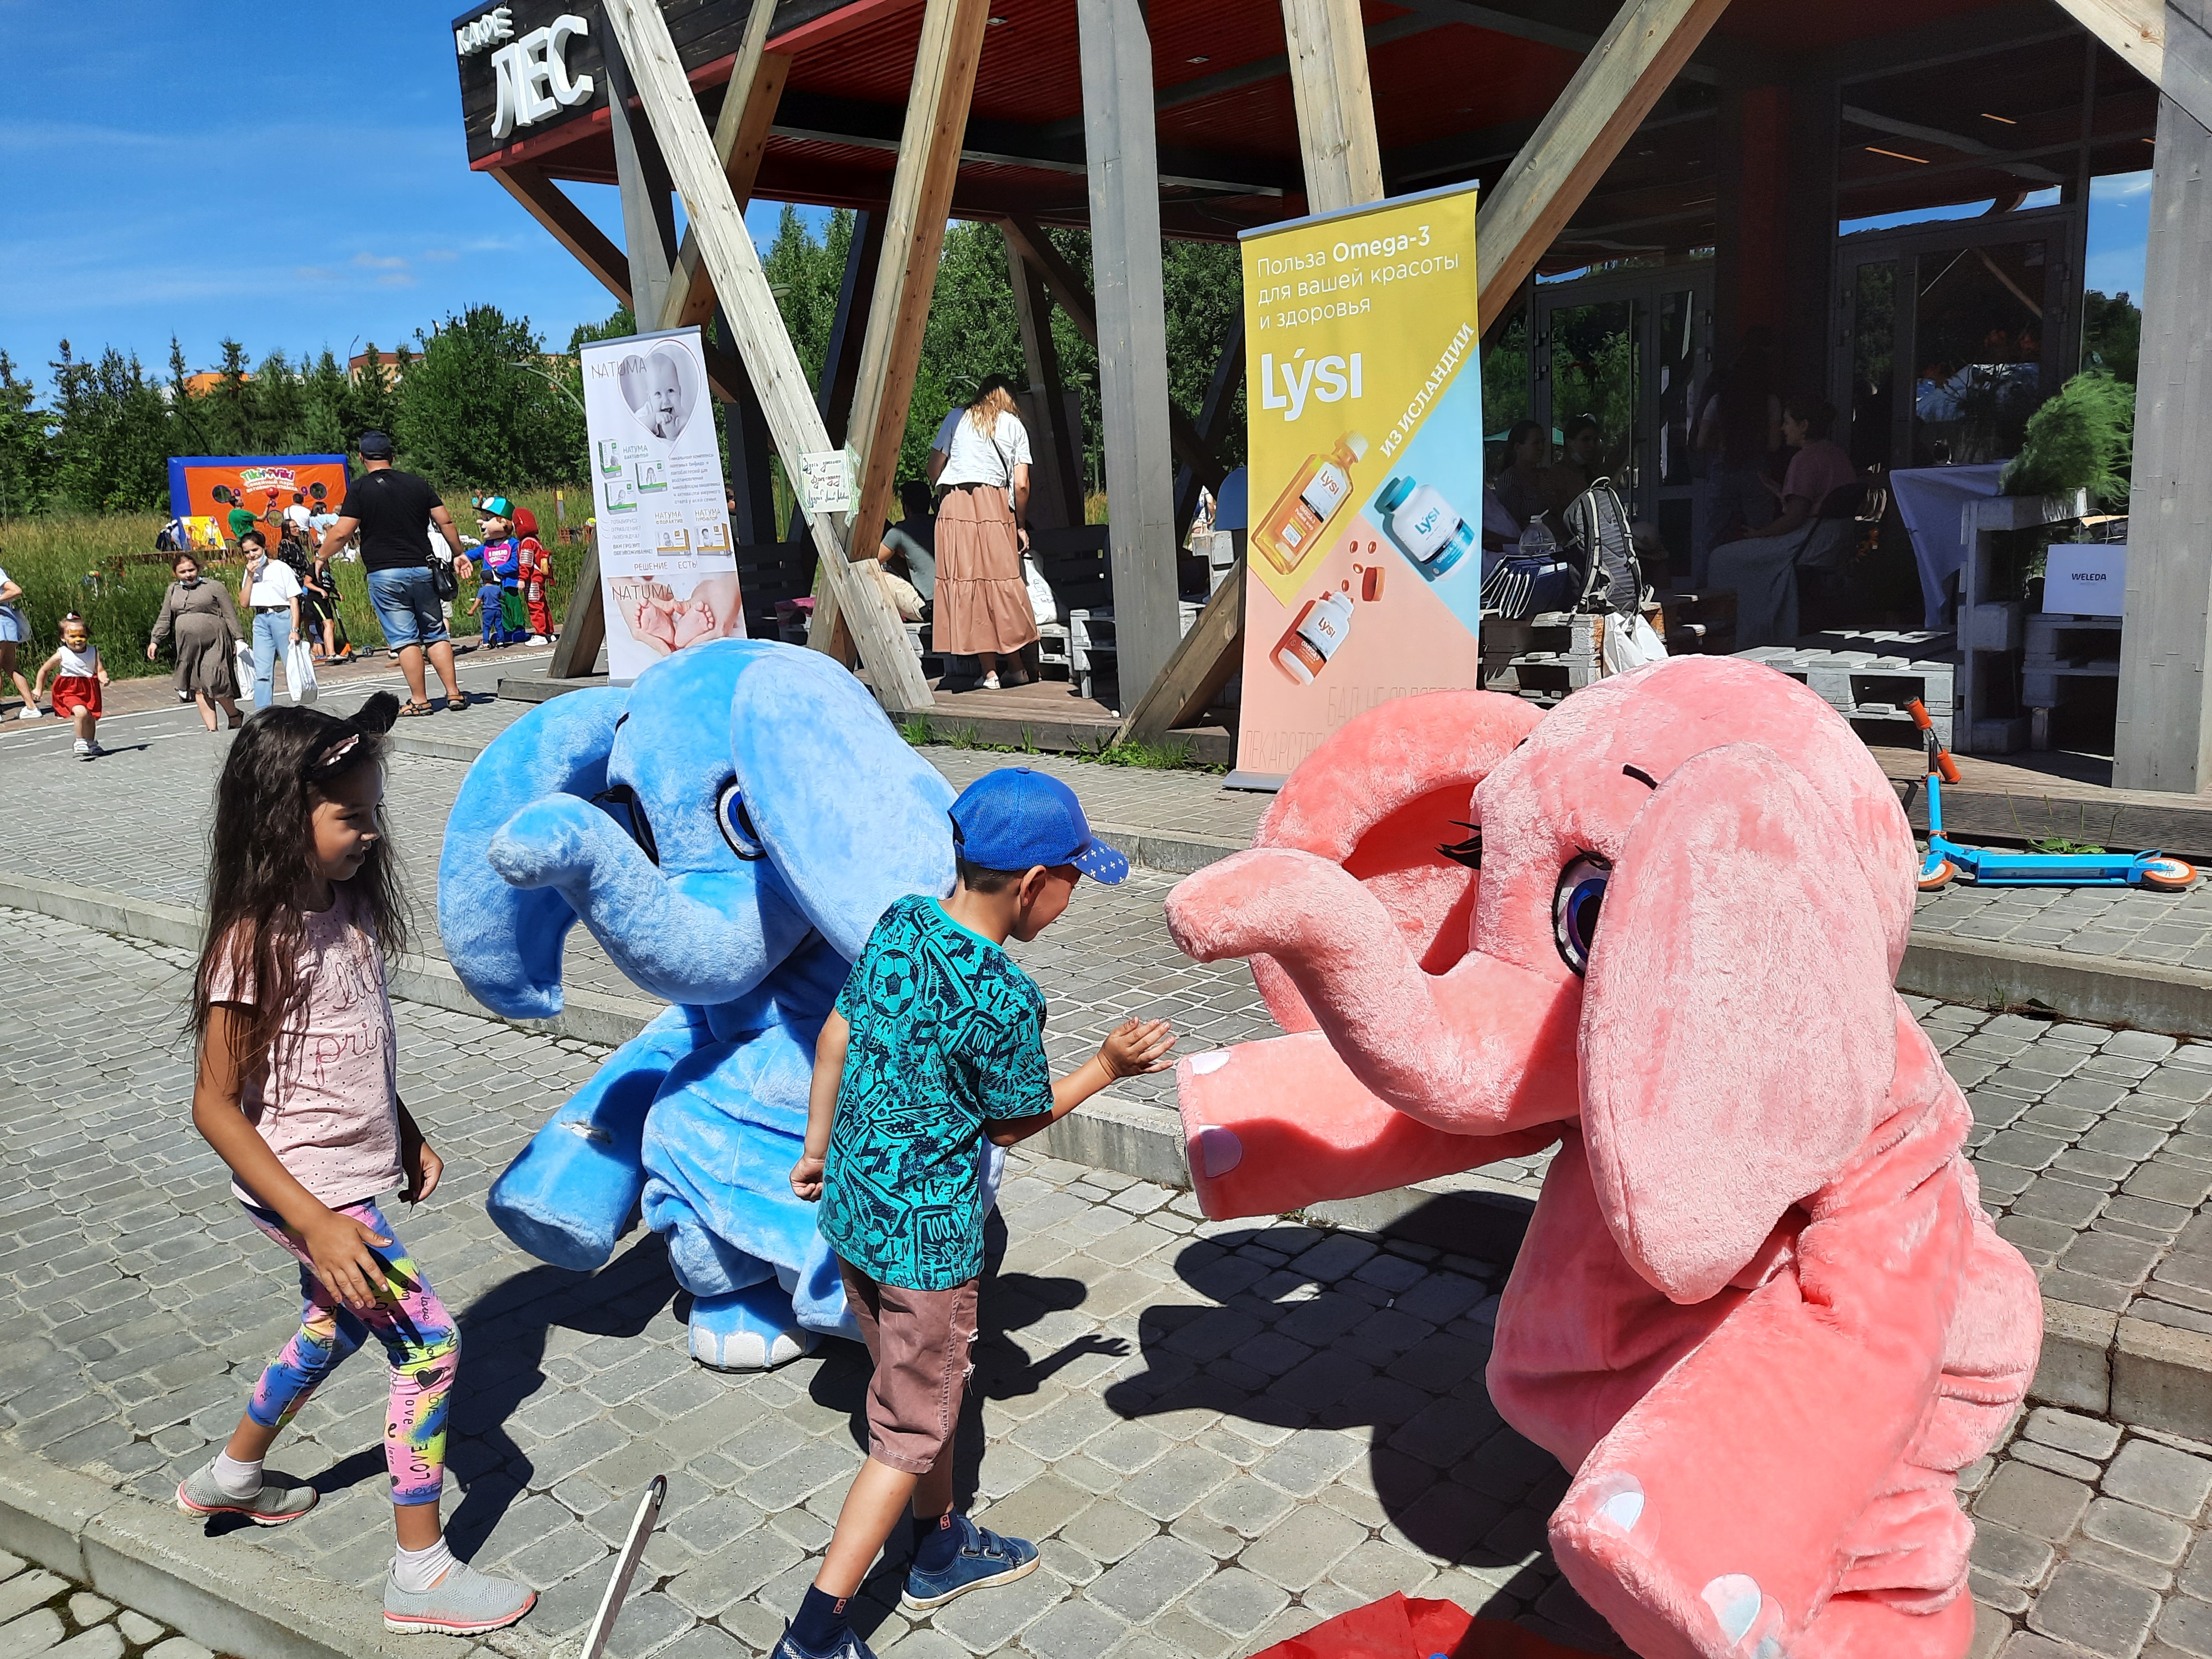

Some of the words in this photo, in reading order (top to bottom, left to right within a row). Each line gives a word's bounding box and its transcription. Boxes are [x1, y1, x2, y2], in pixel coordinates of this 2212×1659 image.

[456, 7, 514, 55] КАФЕ
[492, 14, 594, 138] ЛЕС
[1257, 250, 1327, 278] Польза
[1332, 225, 1431, 263] Omega-3
[1258, 284, 1291, 307] для
[1297, 267, 1364, 296] вашей
[1371, 253, 1460, 286] красоты
[1259, 314, 1270, 330] и
[1277, 298, 1371, 329] здоровья
[591, 357, 648, 379] NATUMA
[1379, 429, 1404, 458] ИЗ
[1397, 322, 1475, 433] ИСЛАНДИИ
[623, 445, 648, 453] НАТУМА
[655, 510, 682, 519] НАТУМА
[695, 508, 722, 517] НАТУМА
[634, 562, 668, 571] РЕШЕНИЕ
[678, 561, 698, 570] ЕСТЬ!
[612, 584, 674, 601] NATUMA
[427, 1391, 440, 1416] LOVE
[411, 1446, 431, 1481] LOVE
[405, 1483, 441, 1496] LOVE
